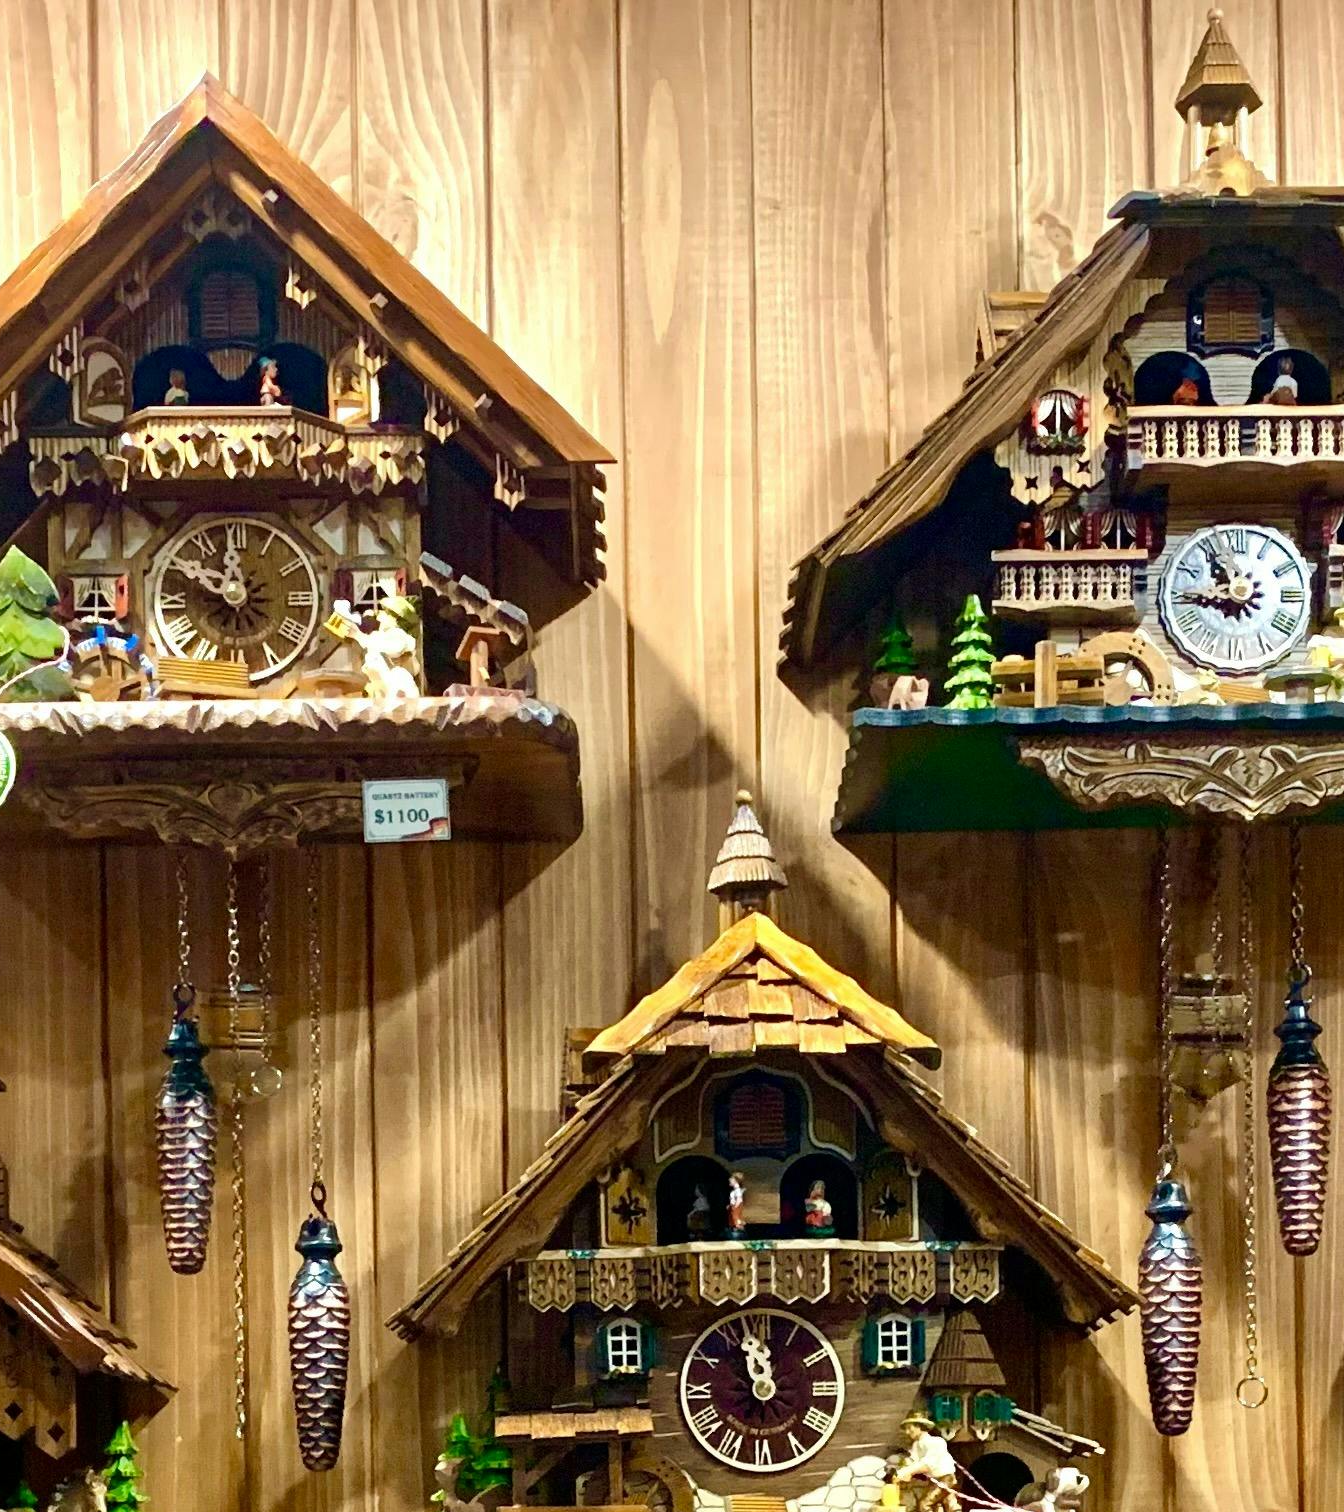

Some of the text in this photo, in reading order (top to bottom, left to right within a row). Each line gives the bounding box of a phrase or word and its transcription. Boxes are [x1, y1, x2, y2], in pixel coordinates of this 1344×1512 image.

[372, 791, 439, 800] QUARTZ BATTERY
[374, 808, 430, 823] $1100
